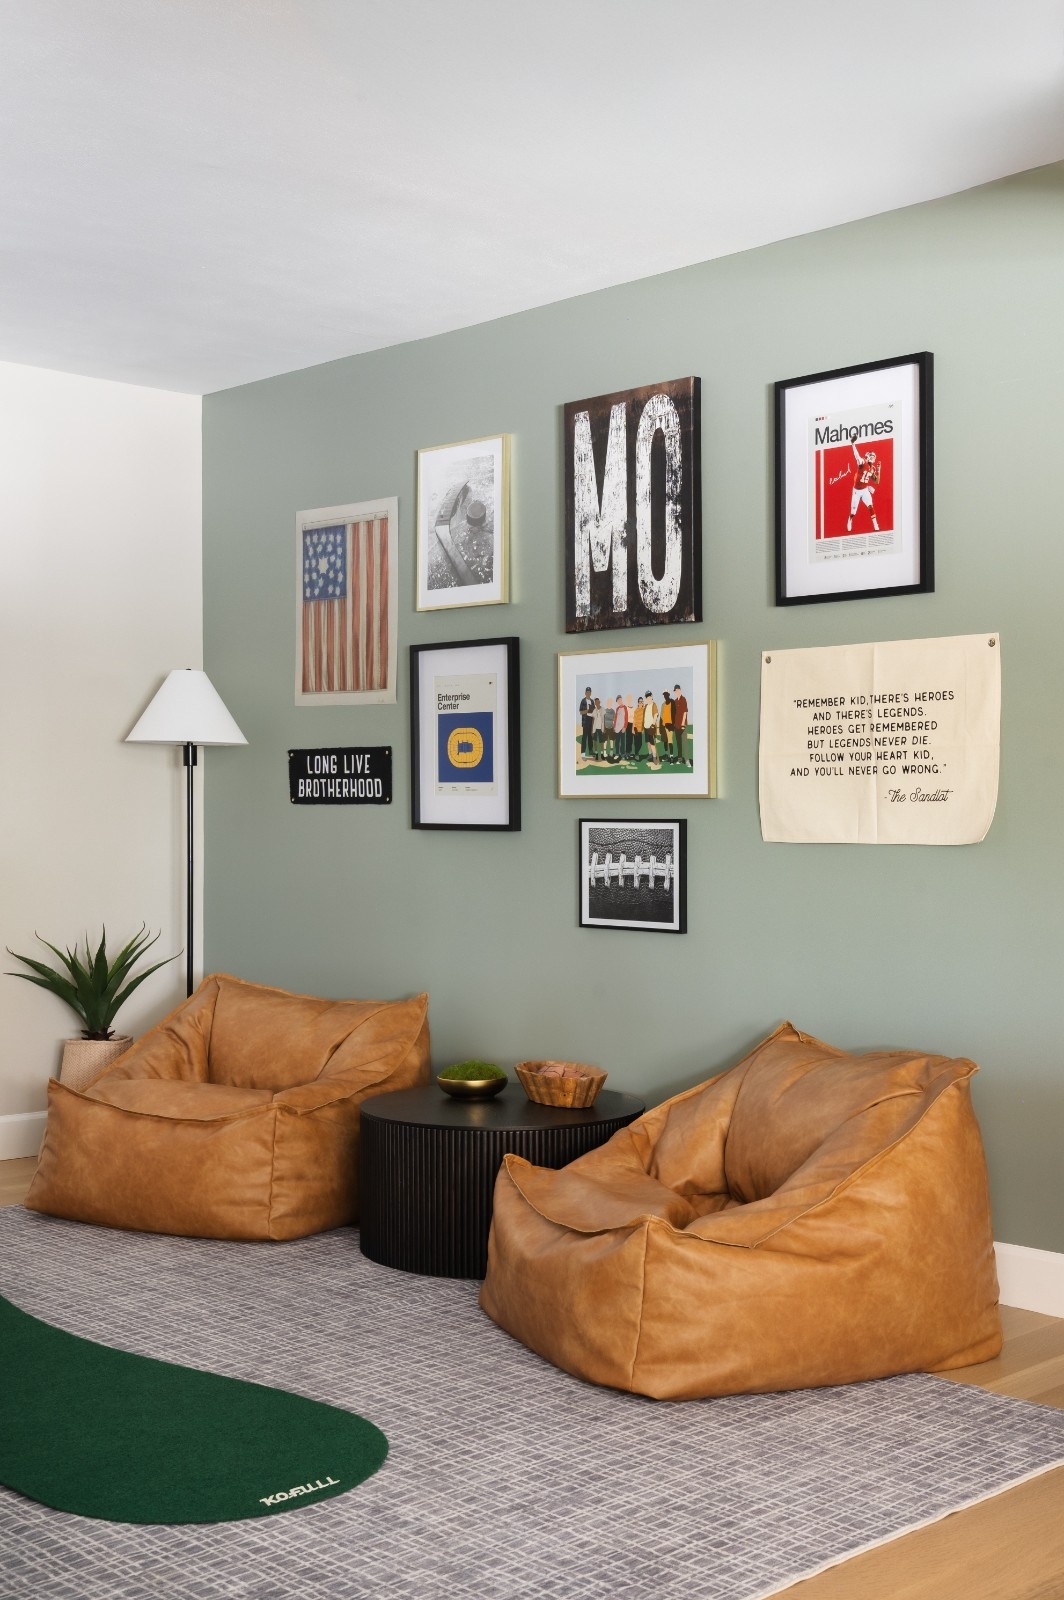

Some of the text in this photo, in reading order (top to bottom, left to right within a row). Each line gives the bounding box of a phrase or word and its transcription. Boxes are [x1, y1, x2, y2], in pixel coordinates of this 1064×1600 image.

[815, 420, 894, 445] Mahomes
[574, 393, 682, 617] MO
[437, 692, 471, 703] Enterprise
[850, 695, 869, 706] KID,
[869, 693, 909, 704] THERE'S
[914, 690, 955, 702] HEROES
[437, 702, 460, 711] Center
[812, 706, 928, 722] AND THERE'S LEGENDS.
[807, 720, 938, 735] HEROES GET REMEMBERED
[807, 735, 932, 749] BUT LEGENDS NEVER DIE.
[809, 749, 934, 763] FOLLOW YOUR HEART KID,
[306, 754, 371, 775] LONG LIVE
[790, 767, 810, 777] AND
[814, 766, 844, 777] YOU'LL
[848, 765, 878, 776] NEVER
[882, 764, 897, 775] GO
[298, 778, 383, 798] BROTHERHOOD
[909, 786, 954, 803] Sandlot
